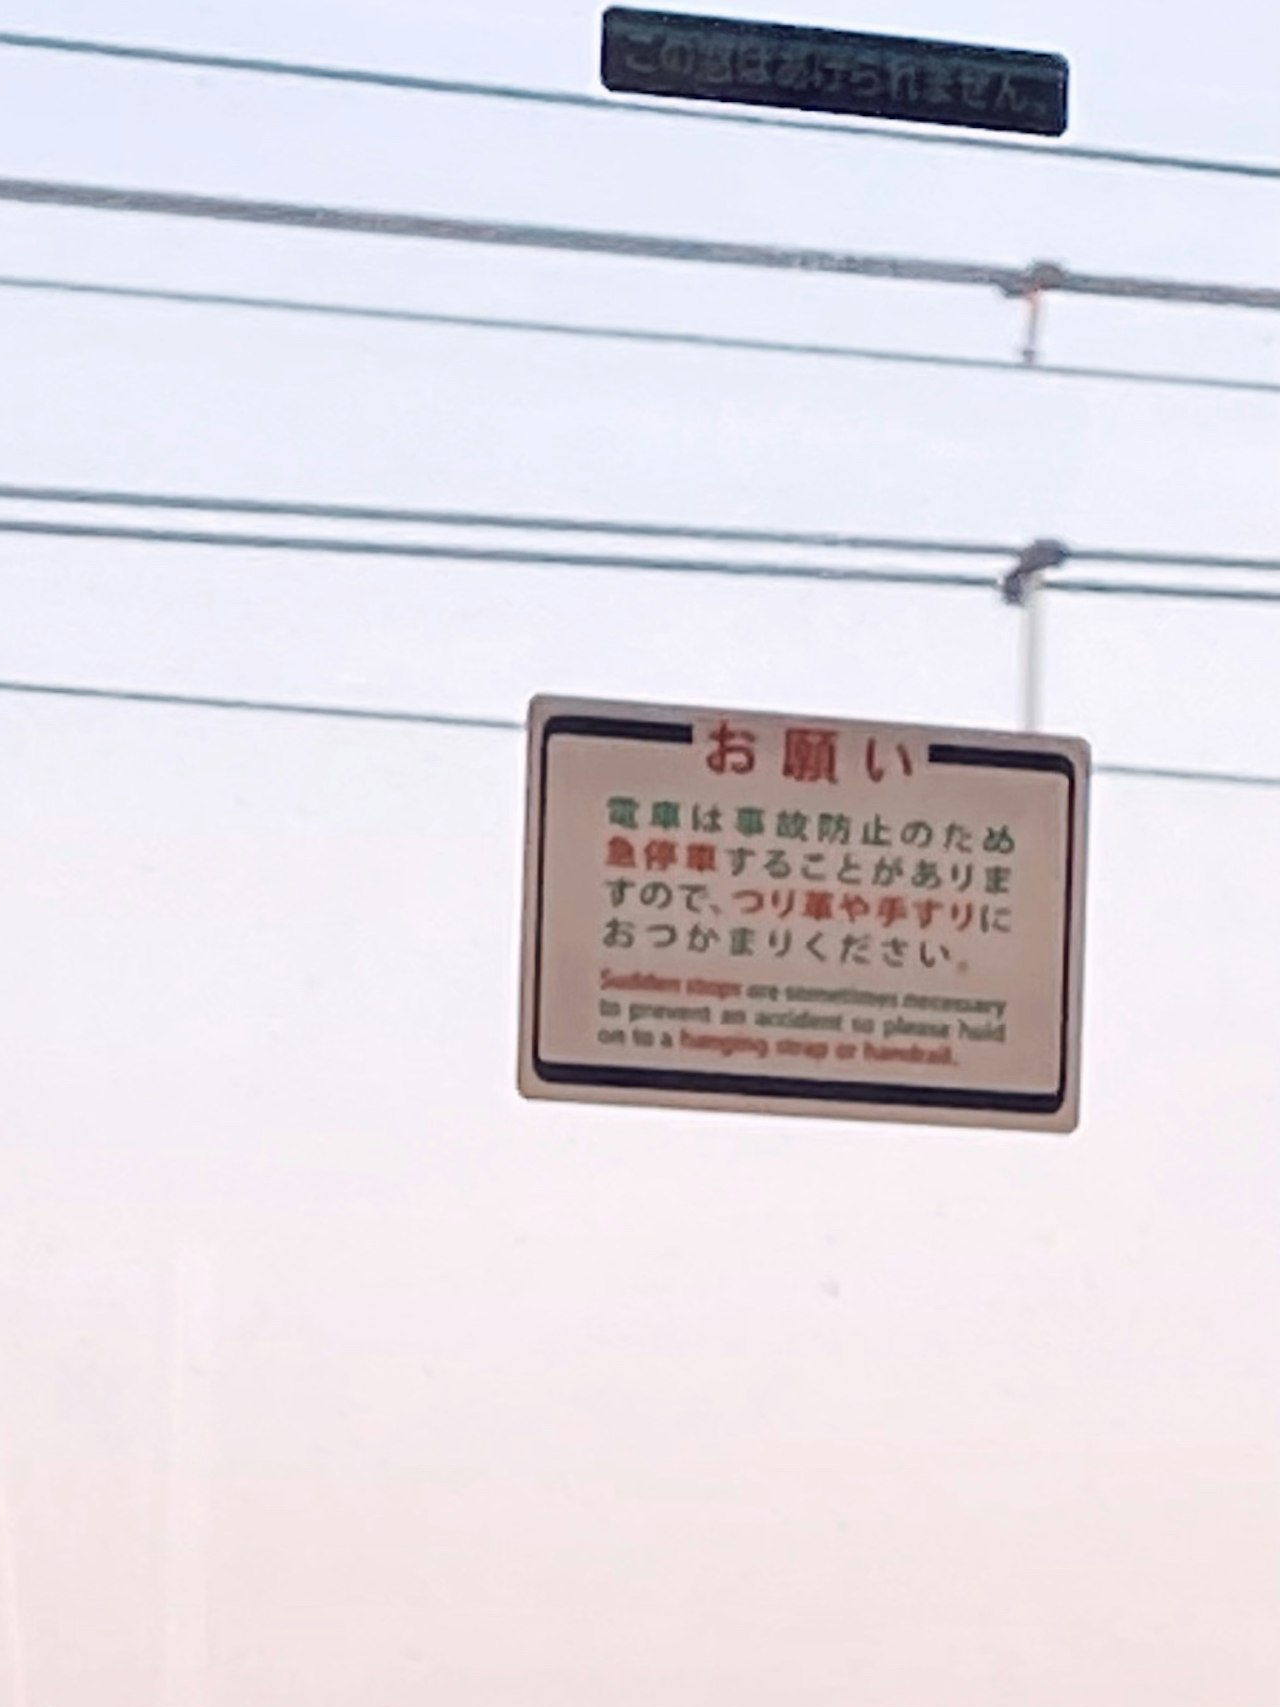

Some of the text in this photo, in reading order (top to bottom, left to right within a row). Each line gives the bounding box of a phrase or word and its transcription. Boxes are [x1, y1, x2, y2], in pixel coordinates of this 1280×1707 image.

[705, 720, 914, 785] お願い
[606, 796, 1016, 856] 電車は事故防止のため
[605, 836, 1013, 895] 急停車することがありま
[604, 877, 1013, 934] すので、つり革や手すりに
[602, 918, 970, 974] おつかまりください。
[599, 999, 621, 1017] to
[629, 1003, 710, 1023] prevent
[721, 1010, 746, 1025] an
[755, 1009, 843, 1031] accident
[883, 1016, 950, 1040] please
[958, 1018, 1006, 1042] hold
[600, 968, 1007, 1019] Sudden stops are sometimes necessary
[597, 1027, 960, 1066] on to a hanging strap or handrail.
